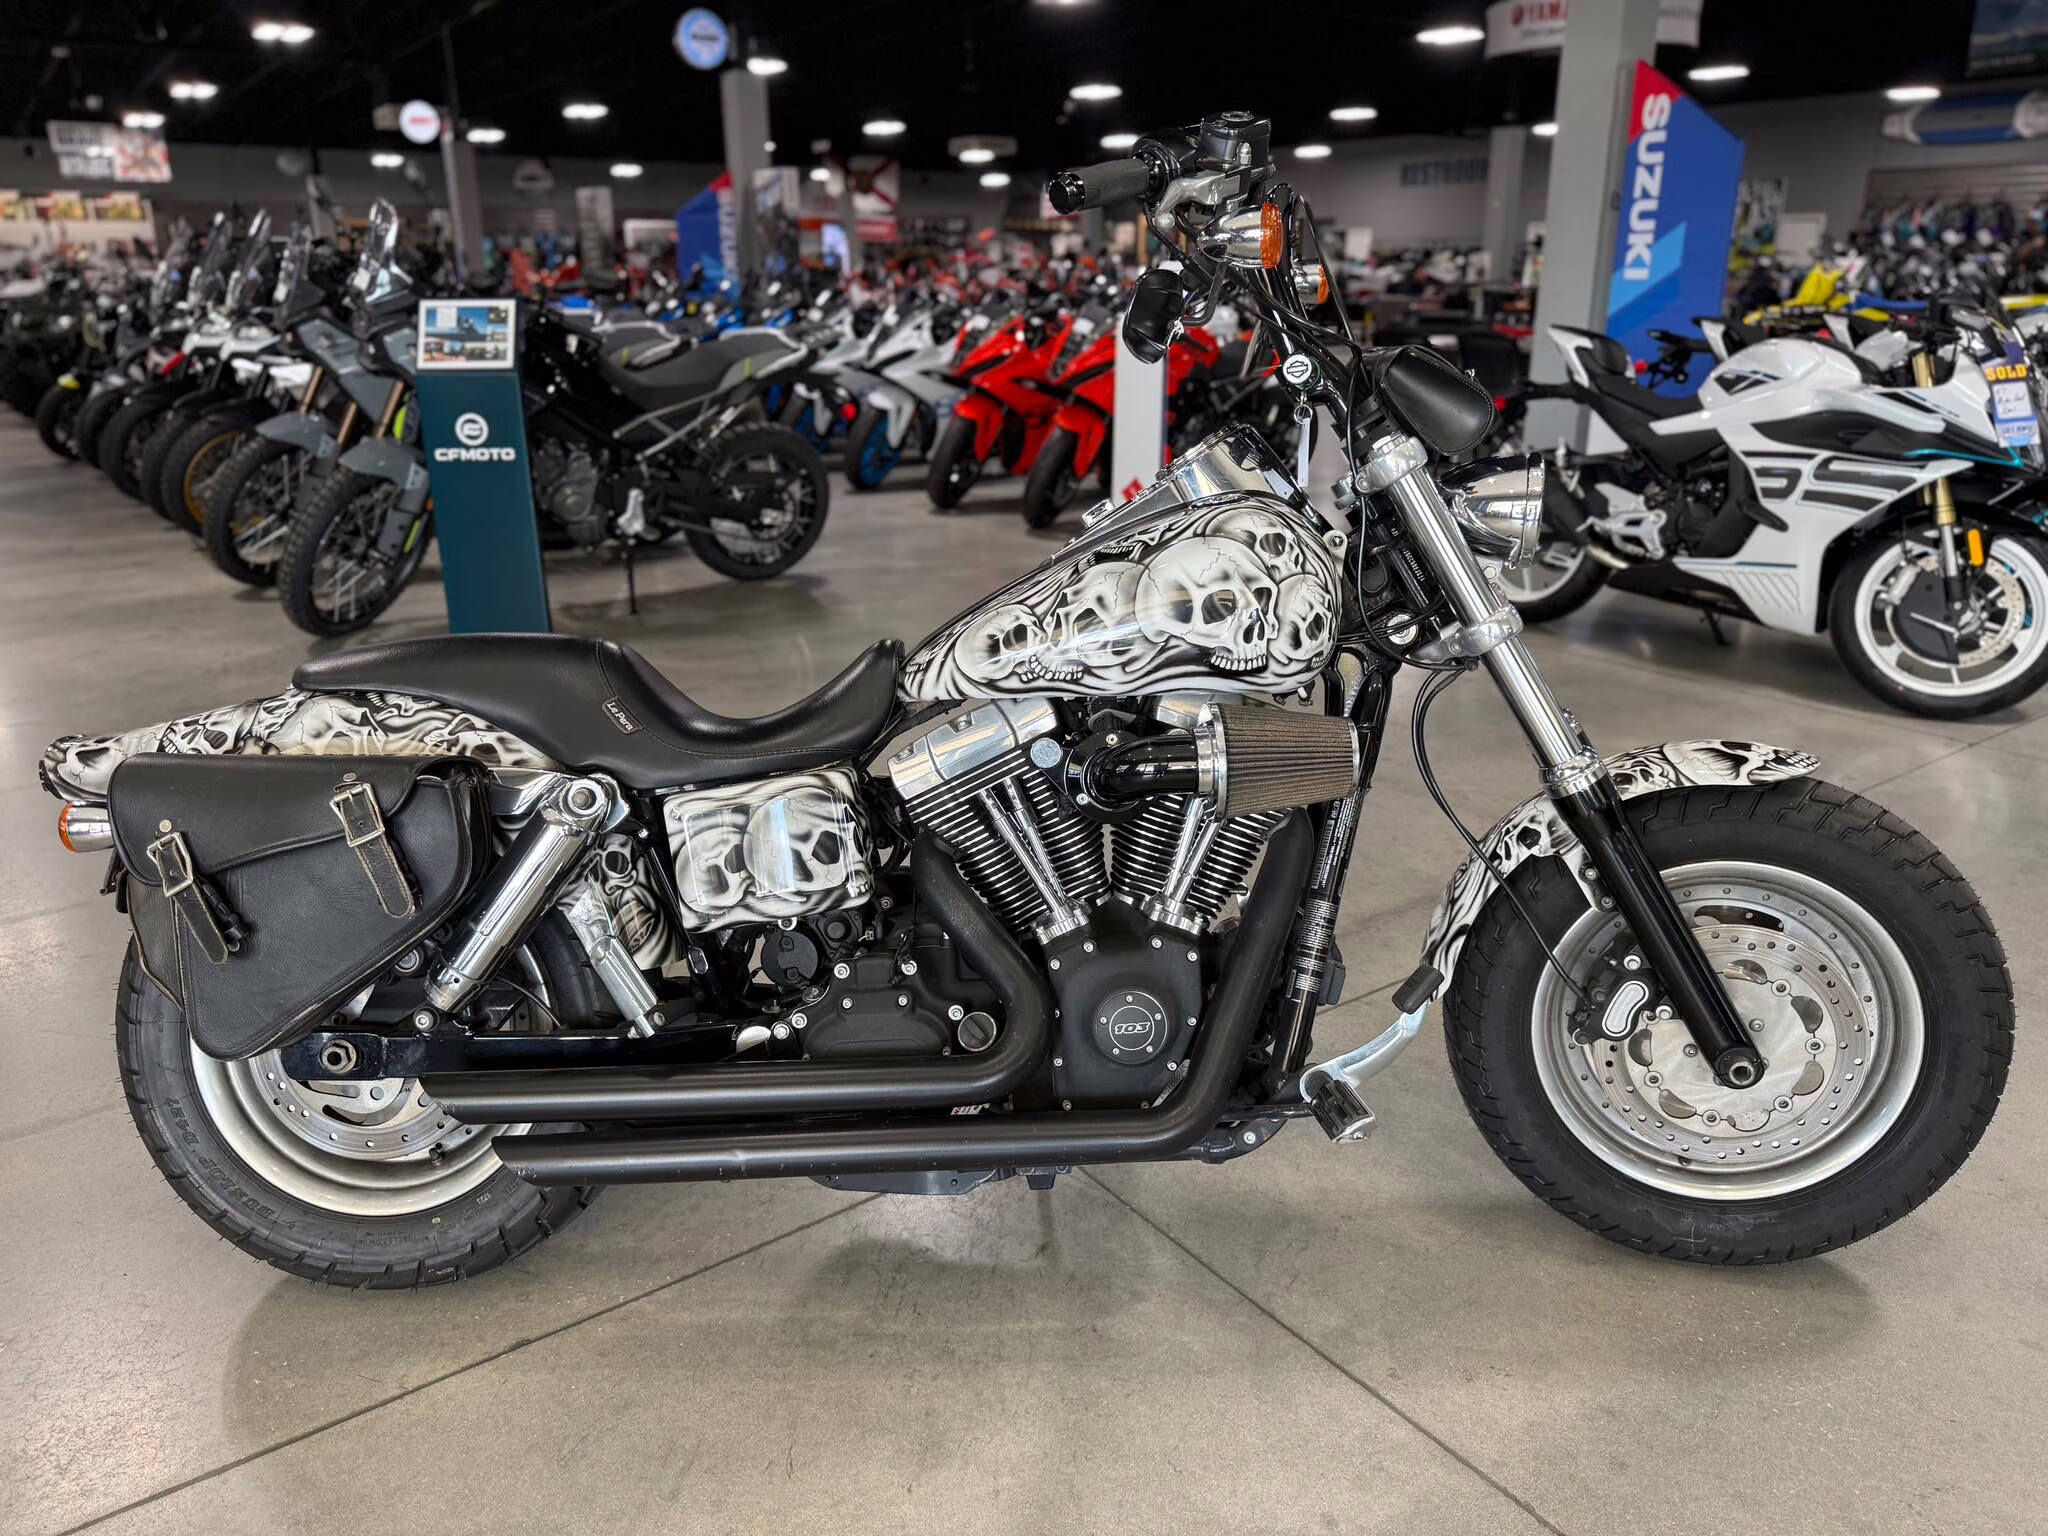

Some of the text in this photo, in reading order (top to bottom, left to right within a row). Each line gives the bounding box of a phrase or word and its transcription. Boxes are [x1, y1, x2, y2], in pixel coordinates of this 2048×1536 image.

[1623, 93, 1672, 280] SUZUKI
[1985, 364, 2028, 381] SOLD
[434, 447, 516, 462] CFMOTO
[1115, 1022, 1150, 1034] 103
[199, 1157, 276, 1218] DUNLOP
